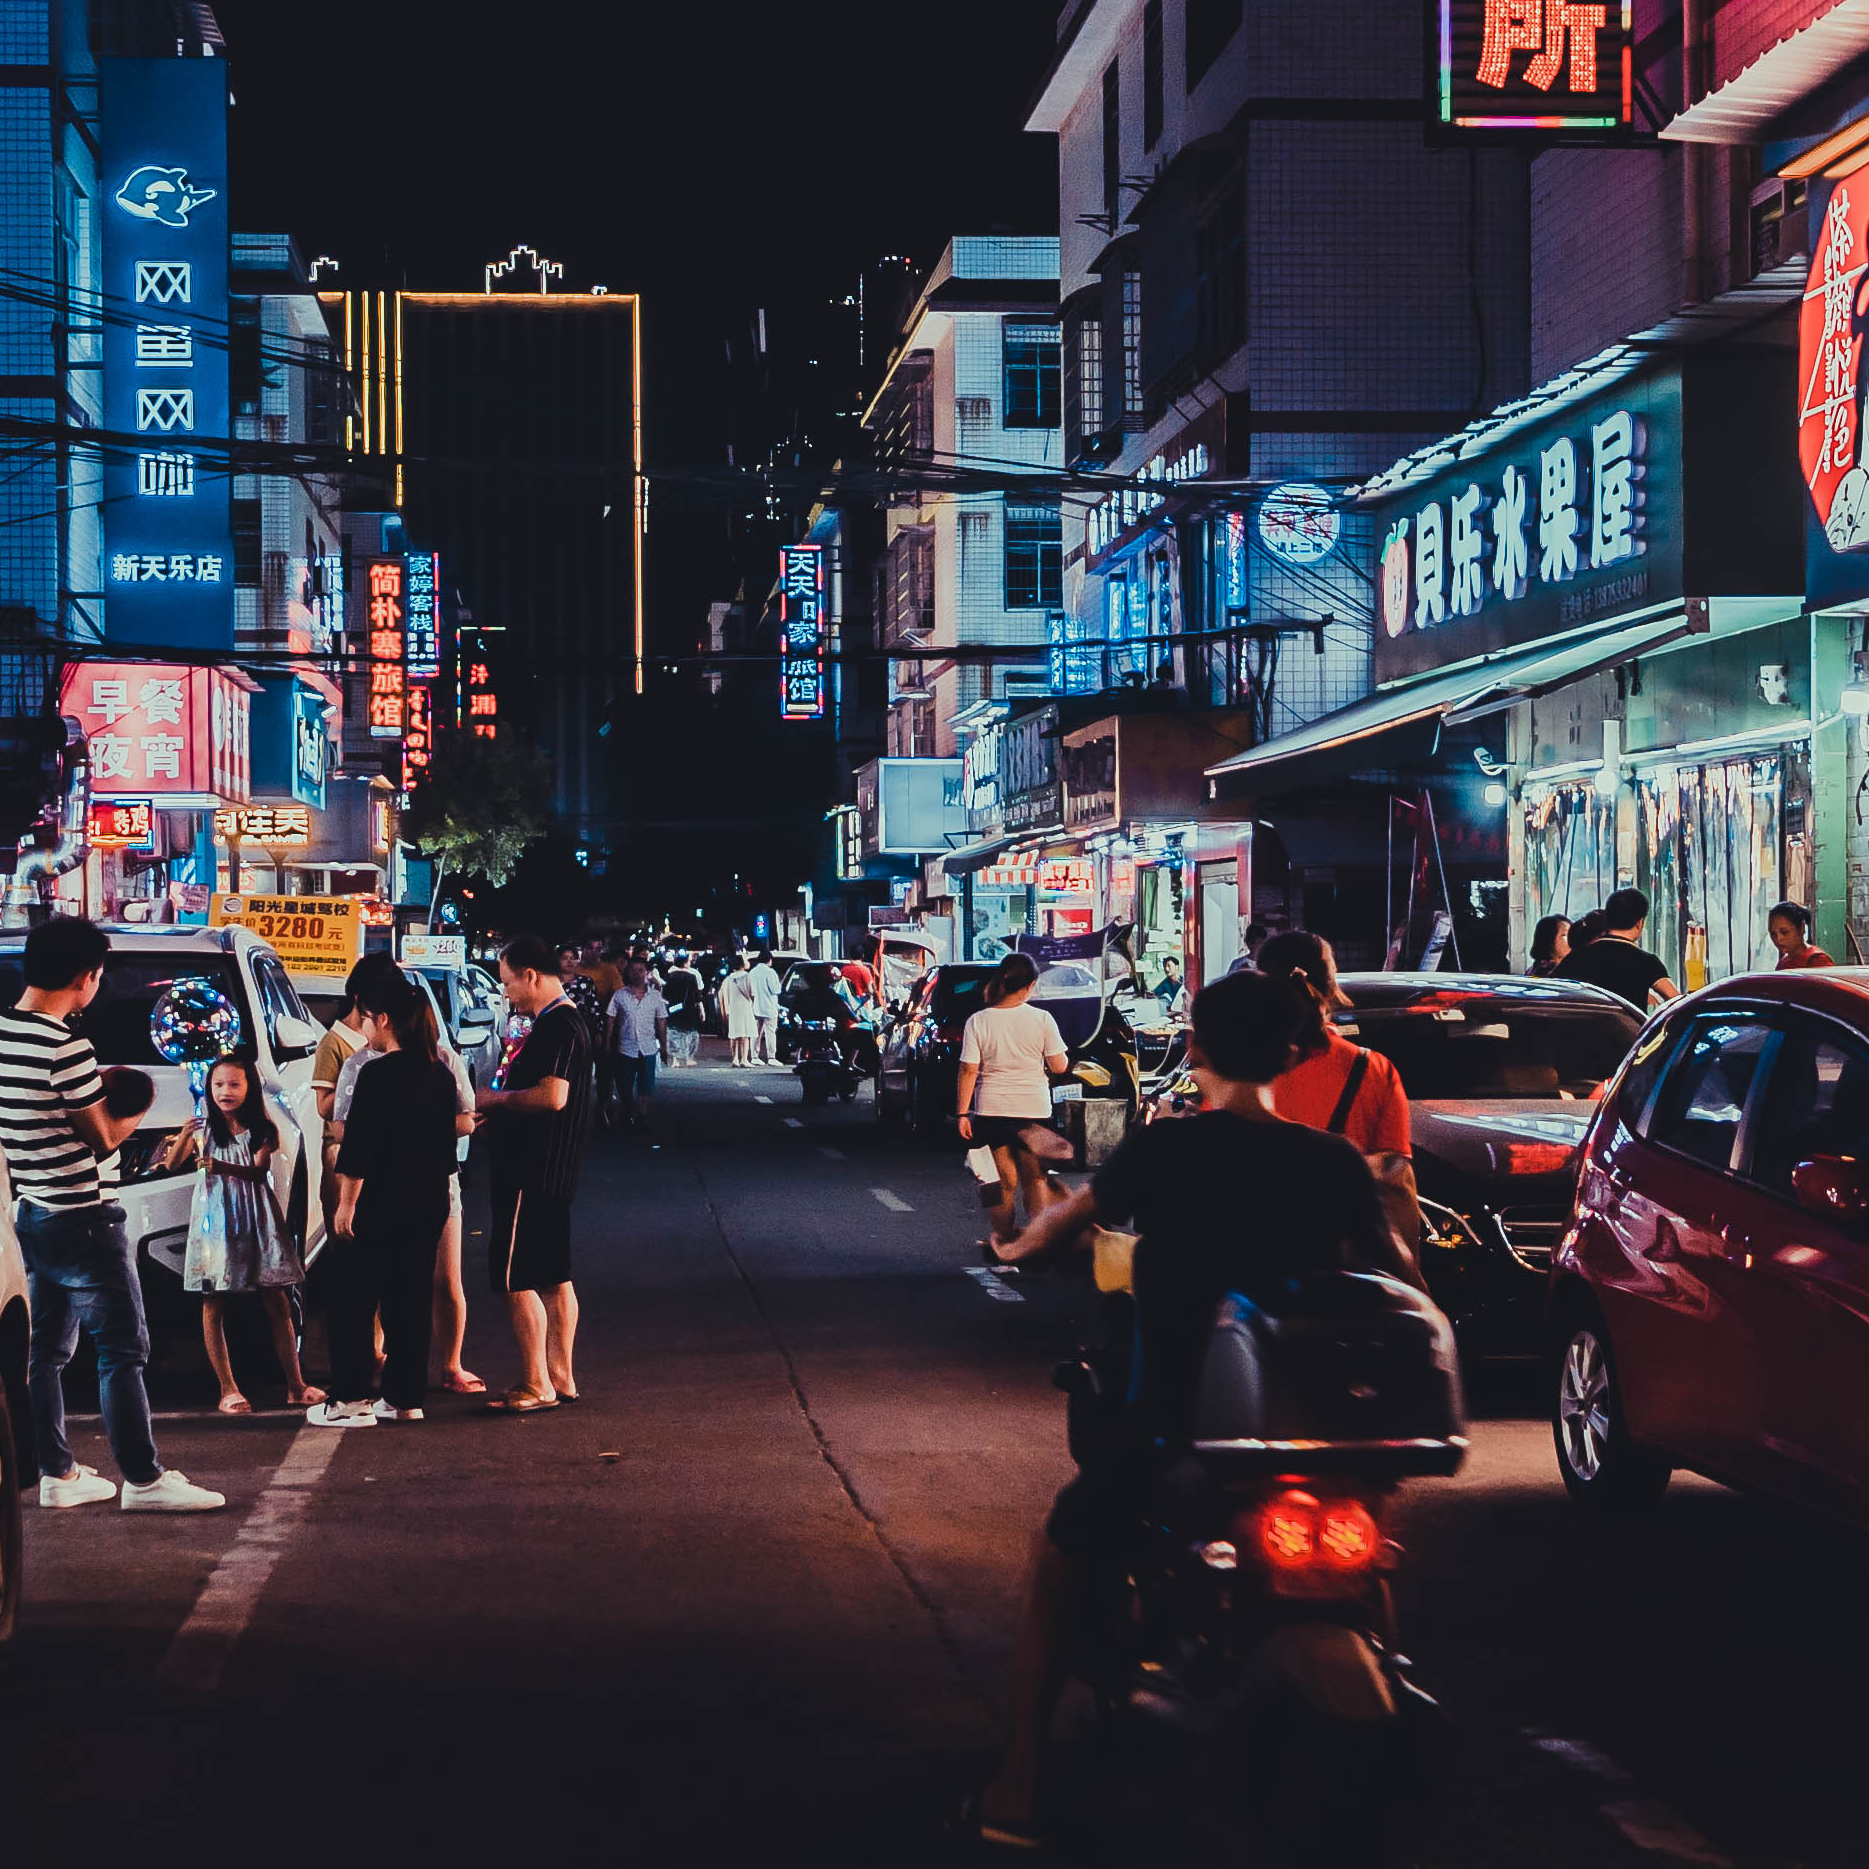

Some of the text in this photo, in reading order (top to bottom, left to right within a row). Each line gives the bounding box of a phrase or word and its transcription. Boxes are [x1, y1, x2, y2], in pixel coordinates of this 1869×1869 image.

[111, 553, 223, 584] 新天乐店
[87, 678, 184, 725] 早餐
[90, 733, 184, 780] 夜宵
[259, 915, 325, 940] 3280
[328, 927, 343, 940] 元
